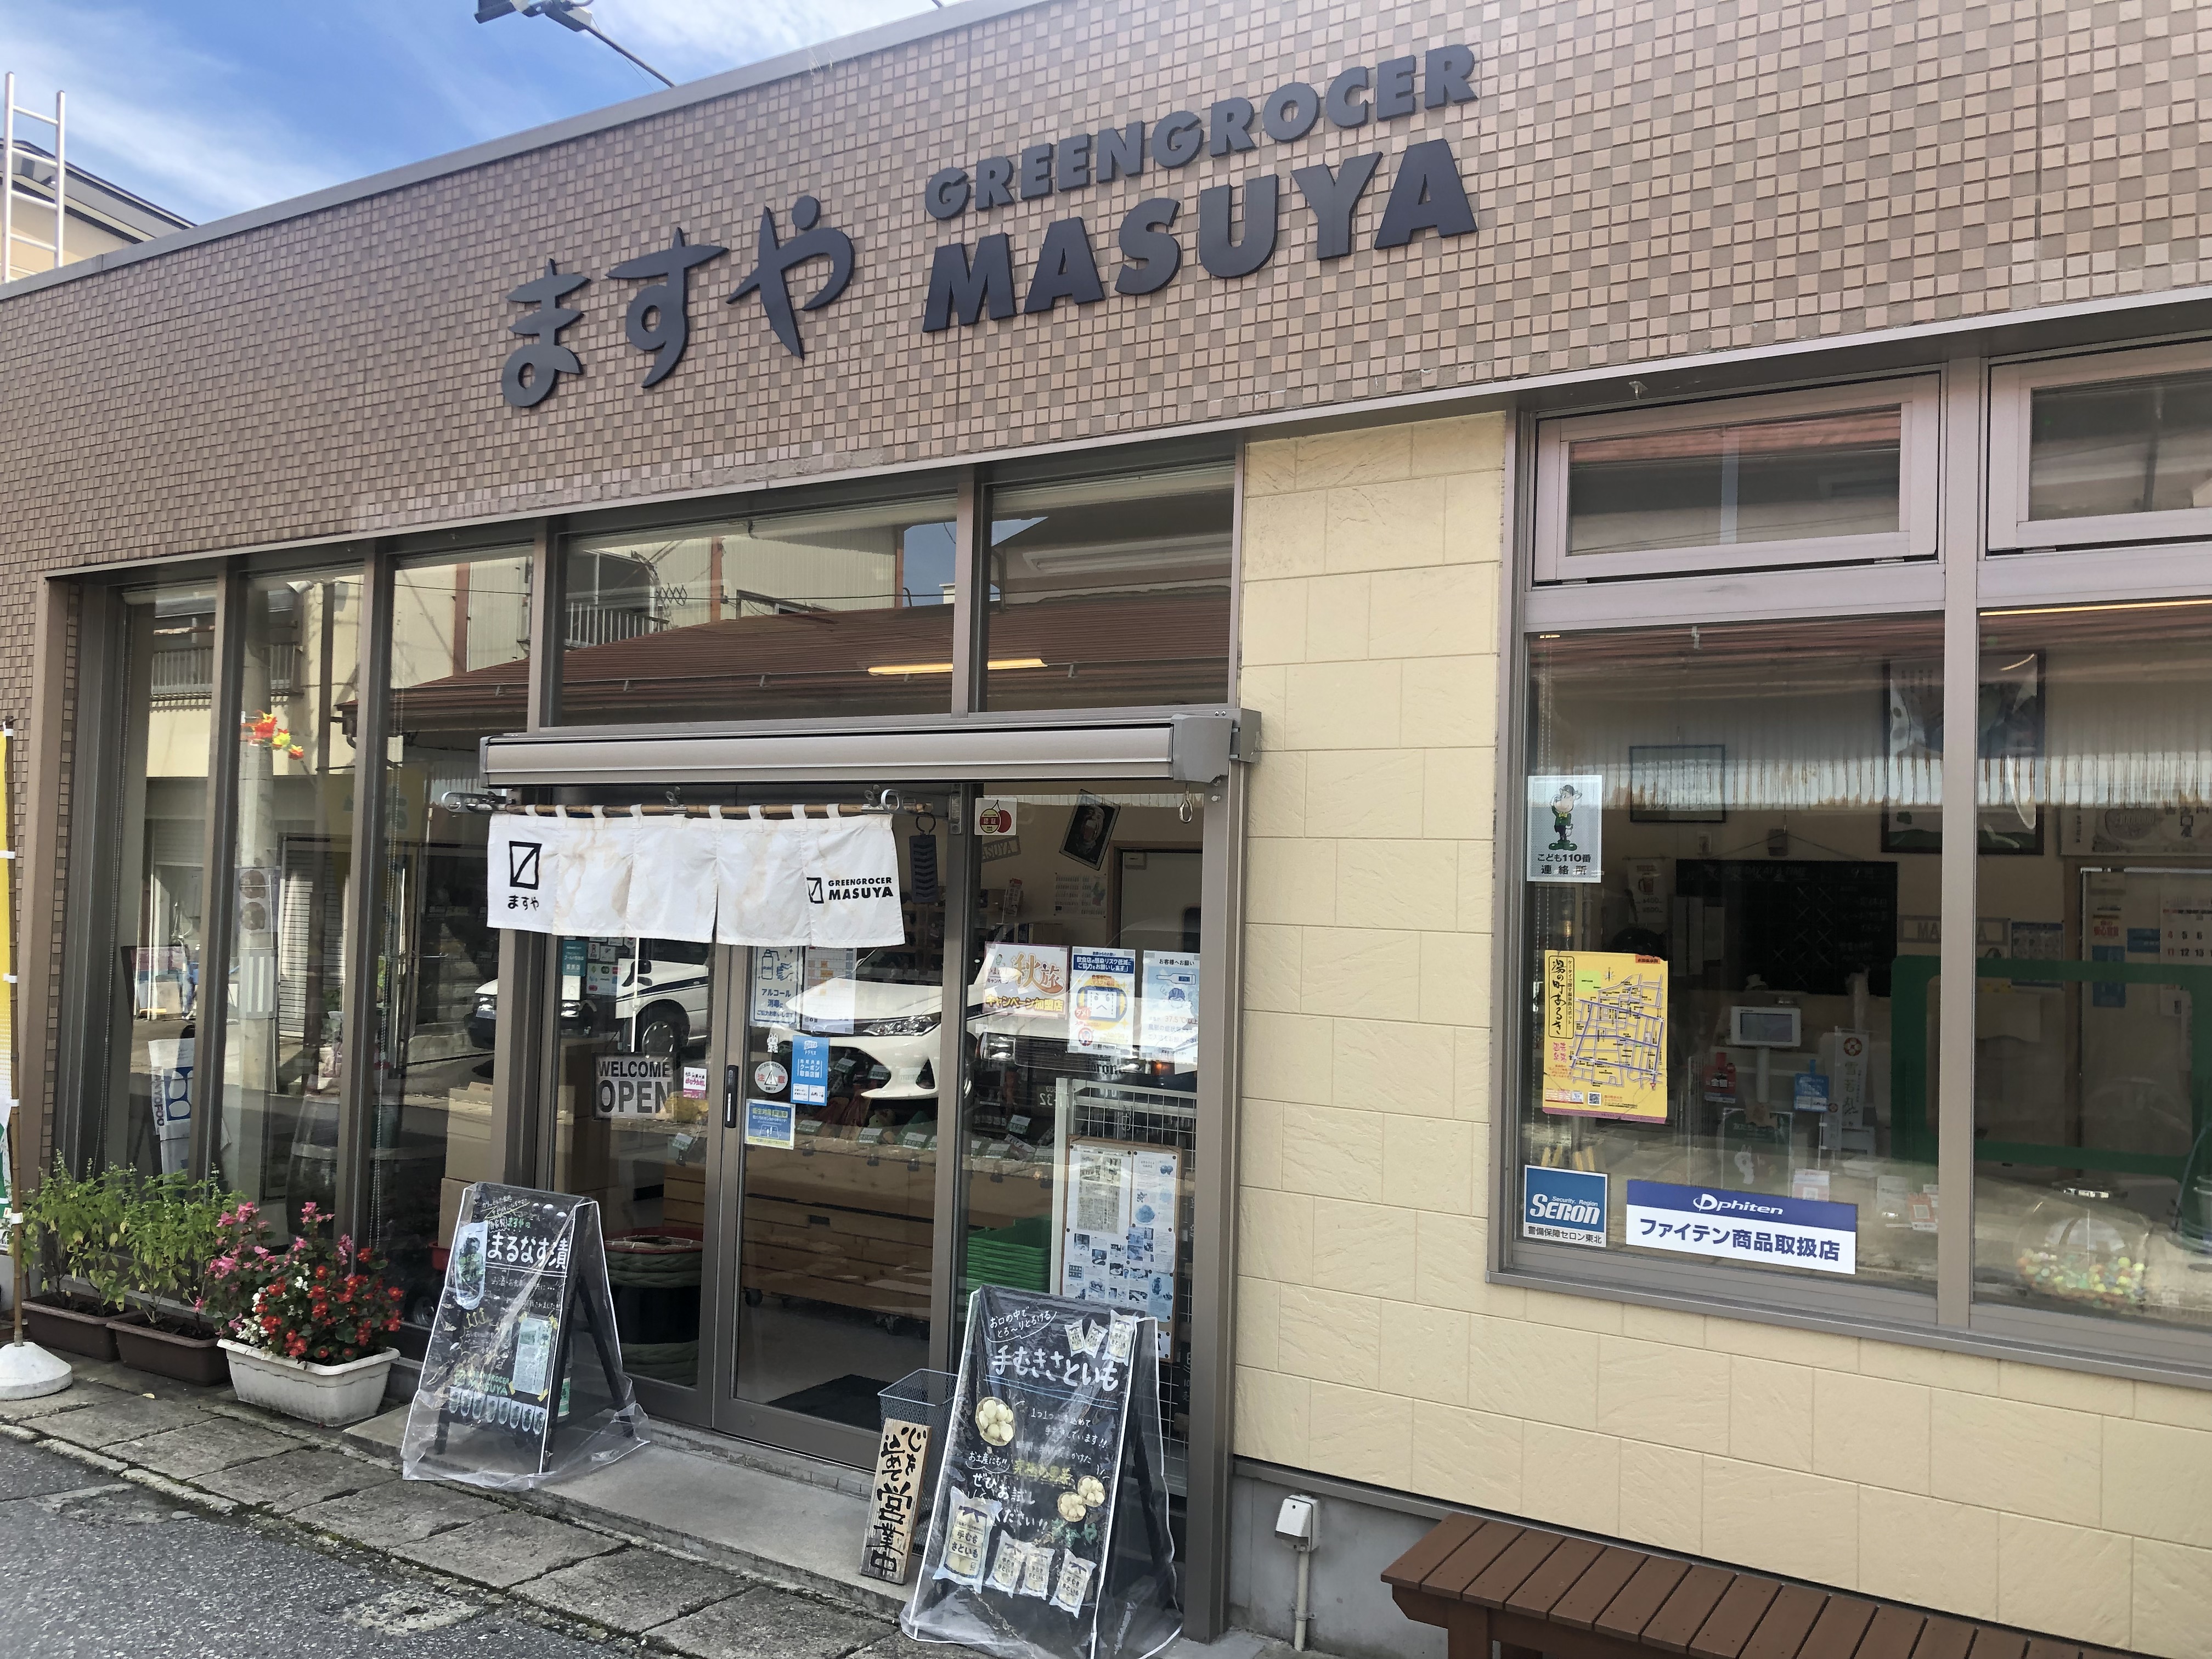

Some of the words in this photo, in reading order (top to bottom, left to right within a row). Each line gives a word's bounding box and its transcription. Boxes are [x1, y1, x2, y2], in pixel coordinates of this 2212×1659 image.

[924, 44, 1478, 221] GREENGROCER
[922, 138, 1479, 334] MASUYA
[500, 194, 856, 408] ますや
[1537, 854, 1591, 863] こども110番
[1541, 865, 1587, 876] 連絡所
[828, 877, 892, 887] GREENGROCER
[507, 894, 539, 911] ますや
[828, 887, 894, 900] MASUYA
[1014, 952, 1064, 994] 秋旅
[761, 989, 792, 997] アルコール
[1550, 958, 1567, 1035] 湯の町あるき
[986, 994, 1064, 1012] キャンペーン加盟店
[598, 1061, 673, 1077] WELCOME
[597, 1080, 673, 1114] OPEN
[1579, 1199, 1598, 1207] Region
[1528, 1226, 1602, 1244] 警備保障セロン東北
[1639, 1218, 1840, 1261] ファイテン商品取扱店
[487, 1231, 569, 1269] まるなす漬
[990, 1306, 1030, 1329] お口の中で
[991, 1345, 1119, 1392] 手むきさといも
[866, 1481, 913, 1576] 営業中
[957, 1530, 978, 1544] 手むき
[951, 1542, 979, 1559] さといも
